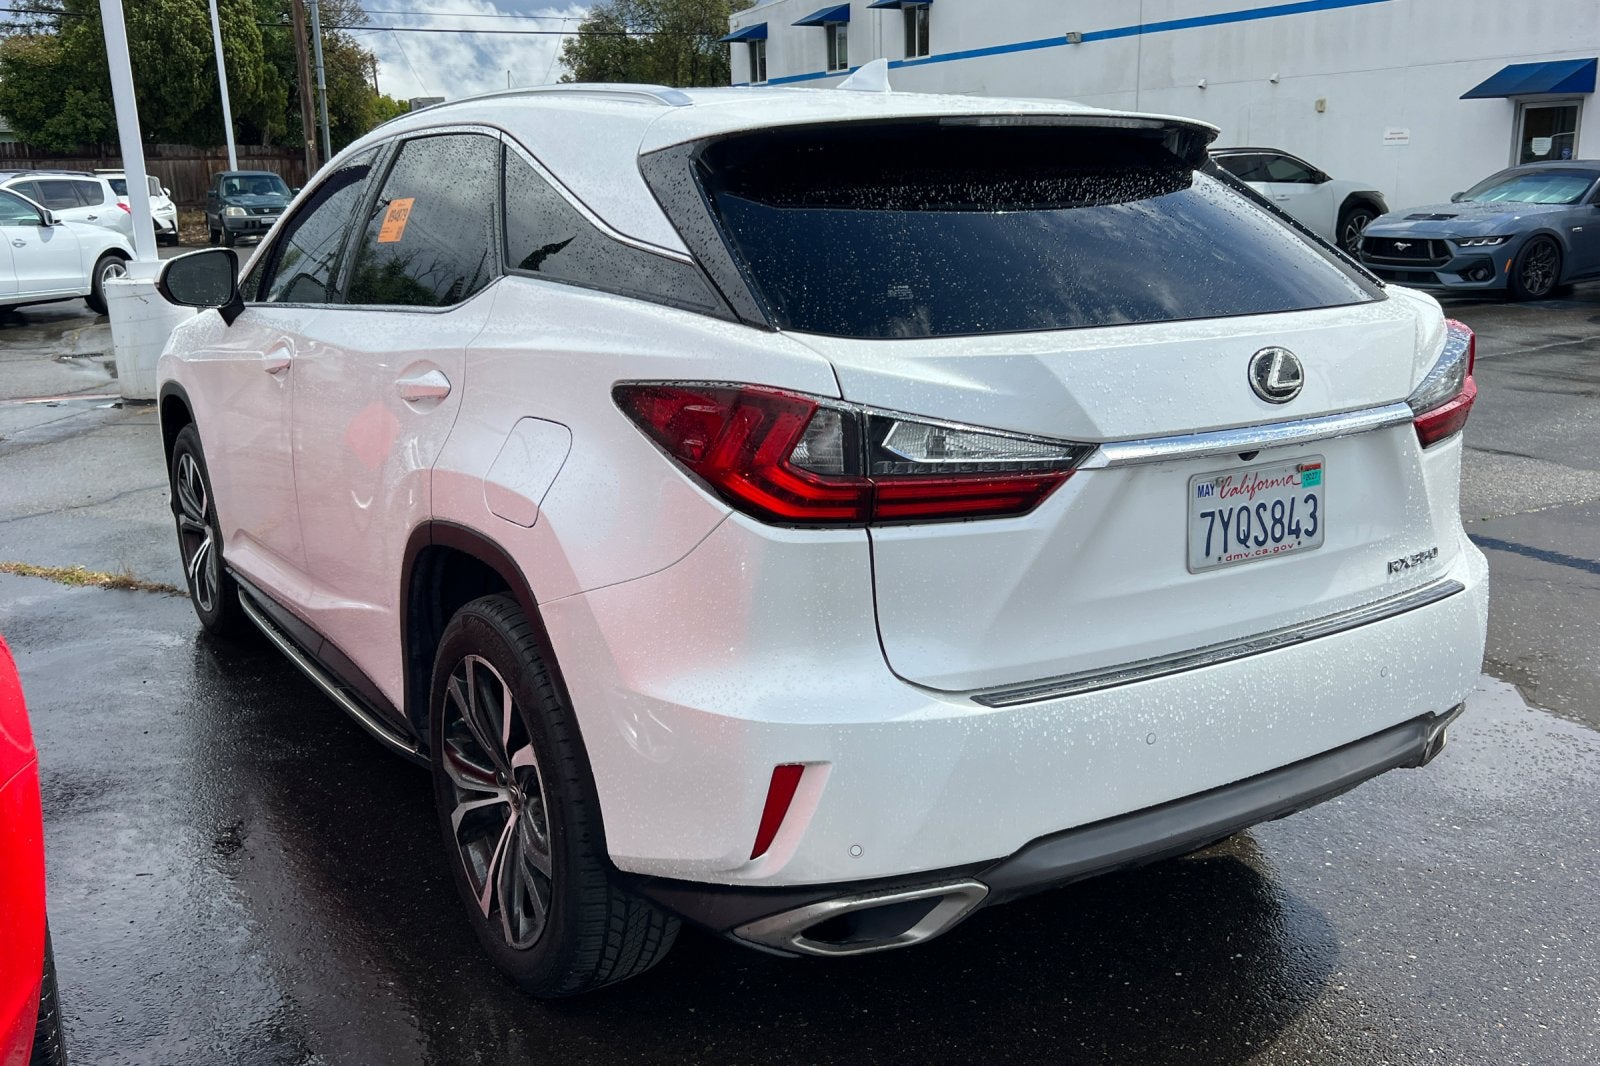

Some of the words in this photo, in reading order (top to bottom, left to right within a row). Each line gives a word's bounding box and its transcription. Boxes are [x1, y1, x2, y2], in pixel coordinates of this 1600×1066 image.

[1197, 483, 1214, 498] MAY
[1219, 472, 1301, 501] California
[1200, 493, 1318, 557] 7YQS843
[1225, 543, 1294, 561] dmv.ca.gov
